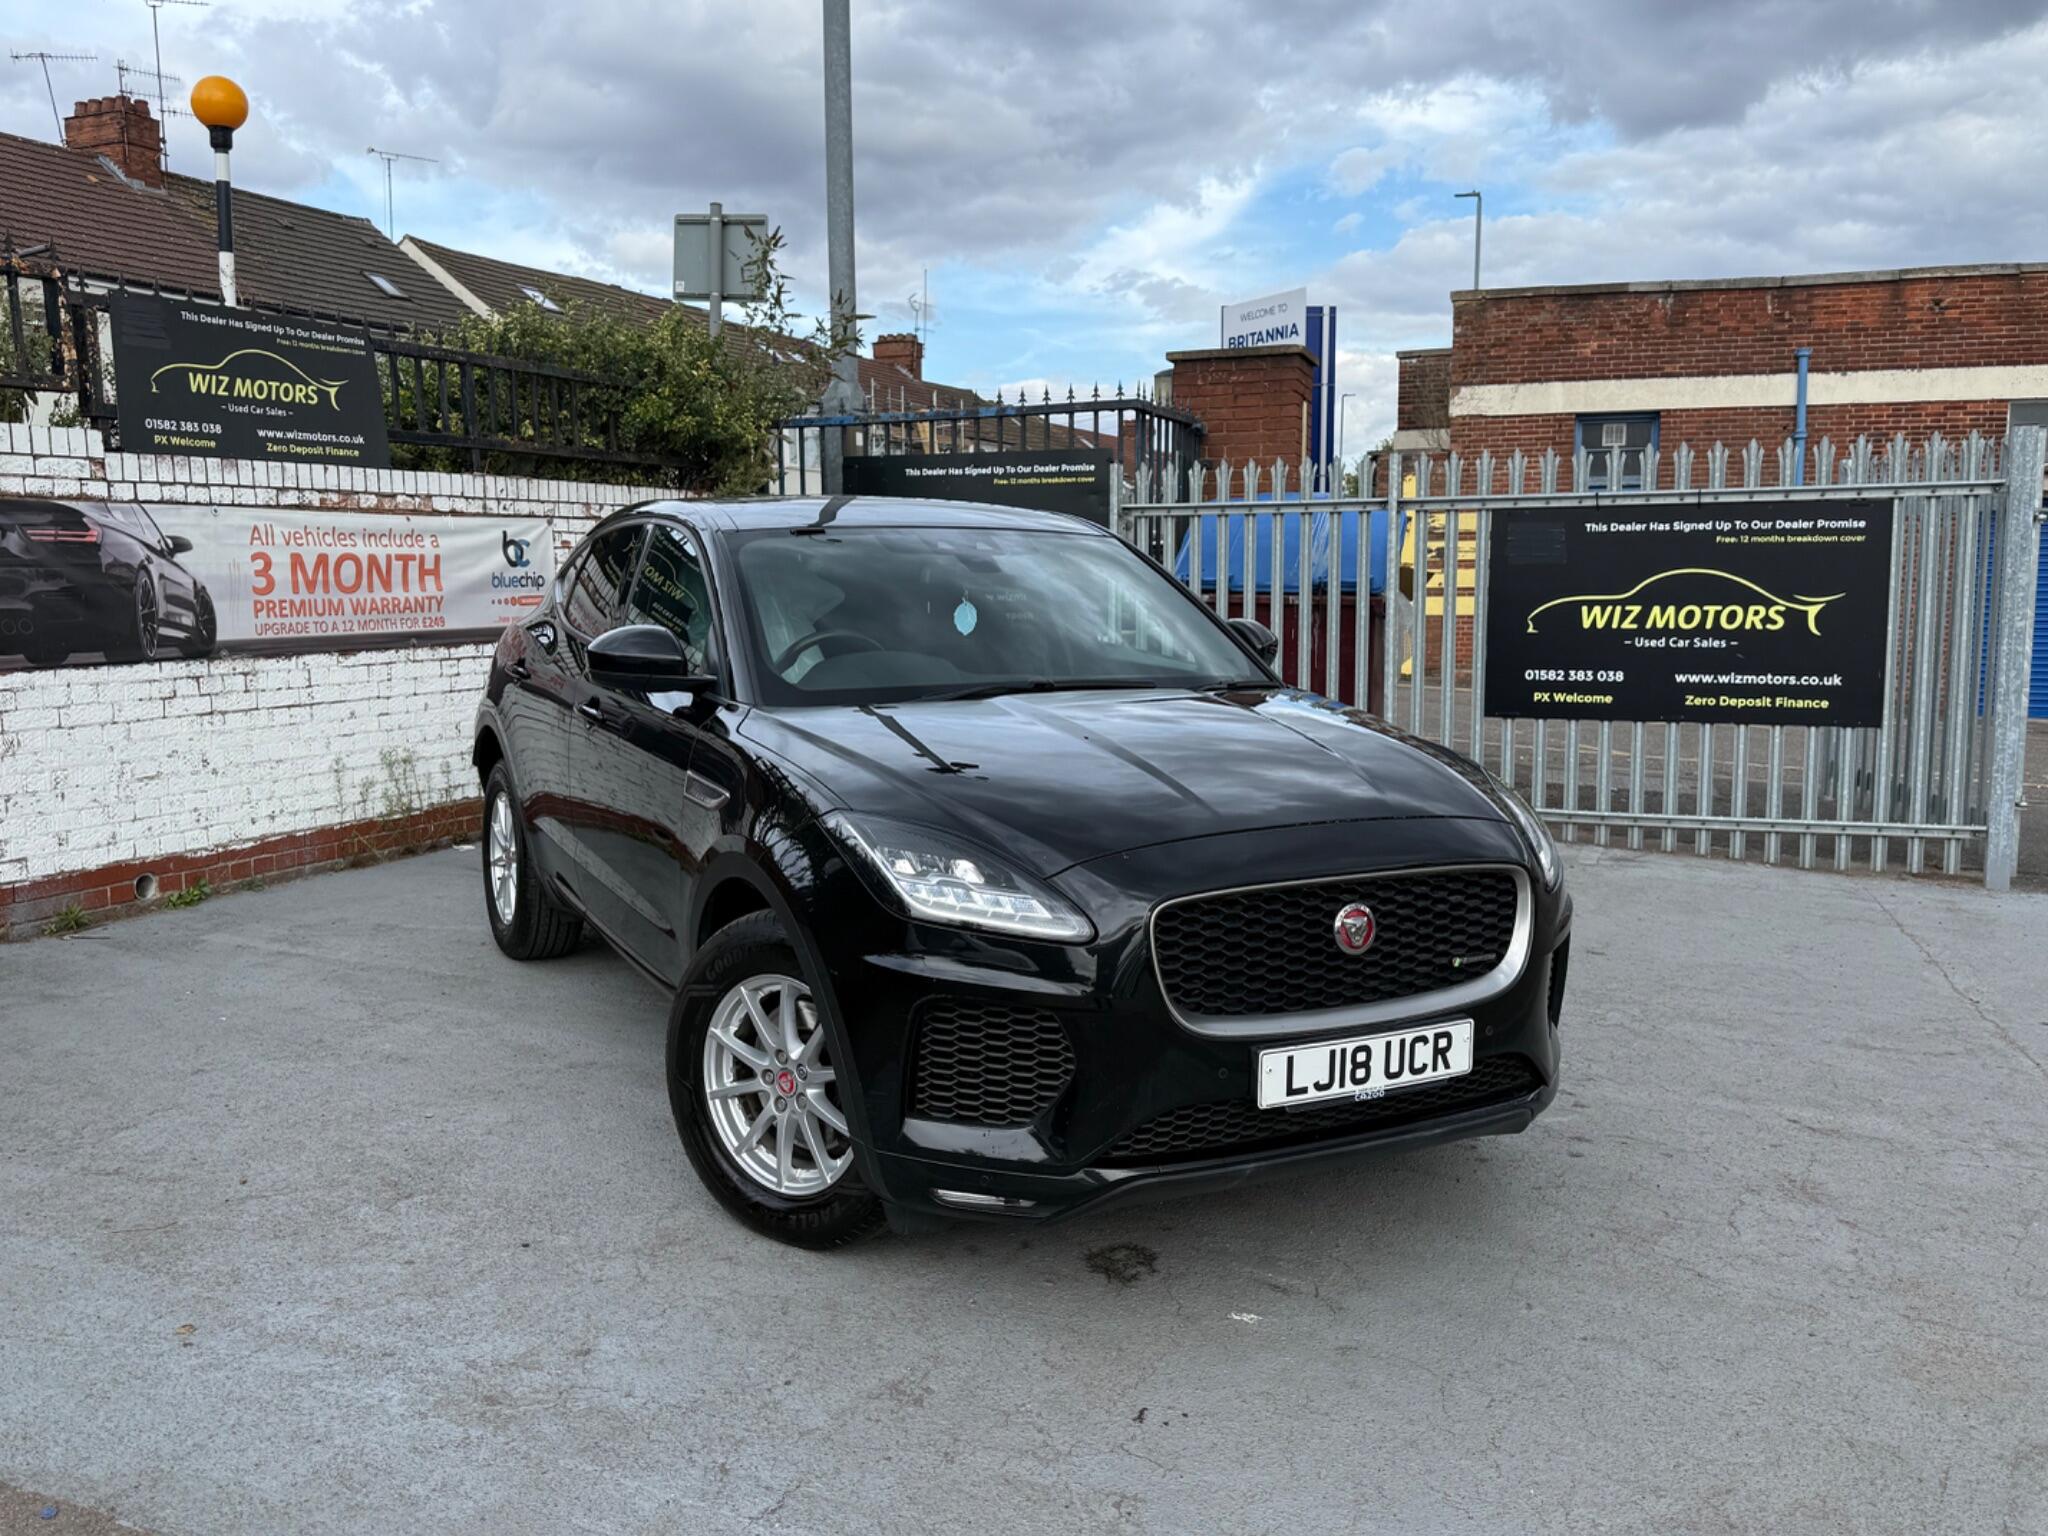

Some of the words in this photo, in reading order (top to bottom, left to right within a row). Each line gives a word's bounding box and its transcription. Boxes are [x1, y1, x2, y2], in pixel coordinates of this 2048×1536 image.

[1240, 305, 1276, 322] WELCOME
[1278, 303, 1288, 312] TO
[180, 311, 199, 322] This
[200, 313, 227, 326] Dealer
[229, 317, 243, 328] Has
[245, 320, 272, 333] Signed
[273, 326, 285, 336] Up
[285, 327, 295, 336] To
[296, 329, 310, 338] Our
[311, 331, 335, 342] Dealer
[336, 335, 365, 346] Promise
[1228, 322, 1299, 349] BRITANNIA
[188, 371, 230, 396] WIZ
[233, 377, 318, 405] MOTORS
[227, 403, 249, 414] Used
[250, 405, 264, 415] Car
[266, 407, 287, 417] Sales
[145, 418, 177, 431] 01582
[180, 420, 200, 432] 383
[202, 421, 222, 434] 038
[154, 435, 168, 445] PX
[170, 436, 216, 448] Welcome
[257, 428, 365, 445] www.wizmotors.co.uk
[266, 443, 288, 453] Zero
[289, 444, 324, 456] Deposit
[325, 446, 360, 457] Finance
[905, 468, 921, 476] This
[922, 467, 947, 476] Dealer
[949, 467, 963, 475] Has
[964, 465, 992, 476] Signed
[993, 466, 1004, 475] Up
[1006, 465, 1016, 474] To
[1017, 465, 1032, 474] Our
[1033, 464, 1060, 473] Dealer
[1061, 462, 1095, 472] Promise
[1041, 476, 1076, 484] breakdown
[1585, 522, 1608, 532] This
[1610, 521, 1647, 531] Dealer
[1650, 521, 1670, 531] Has
[1673, 520, 1712, 532] Signed
[1715, 520, 1731, 532] Up
[1734, 520, 1749, 530] To
[1751, 519, 1773, 530] Our
[1775, 519, 1814, 529] Dealer
[1817, 518, 1866, 529] Promise
[250, 524, 275, 546] All
[280, 525, 358, 547] vehicles
[362, 527, 424, 548] include
[430, 533, 440, 548] a
[1740, 535, 1749, 543] 12
[1750, 535, 1785, 543] months
[1787, 534, 1838, 543] breakdown
[250, 552, 276, 596] 3
[289, 552, 444, 595] MONTH
[491, 571, 546, 591] bluechip
[253, 599, 345, 619] PREMIUM
[349, 596, 445, 616] WARRANTY
[254, 620, 310, 636] UPGRADE
[313, 620, 329, 634] TO
[331, 620, 339, 633] A
[341, 619, 355, 632] 12
[357, 617, 398, 631] MONTH
[400, 617, 420, 630] FOR
[422, 616, 446, 629] £249
[1580, 605, 1642, 629] WIZ
[1645, 605, 1786, 631] MOTORS
[1634, 637, 1665, 648] Used
[1669, 637, 1690, 648] Car
[1693, 637, 1726, 648] Sales
[1524, 669, 1565, 681] 01582
[1568, 670, 1594, 682] 383
[1597, 670, 1624, 682] 038
[1674, 672, 1843, 687] www.wizmotors.co.uk
[1533, 692, 1550, 702] PX
[1553, 692, 1613, 704] Welcome
[1685, 695, 1716, 706] Zero
[1719, 696, 1772, 709] Deposit
[1775, 697, 1830, 709] Finance
[1285, 1044, 1372, 1097] LJ18
[1384, 1030, 1453, 1080] UCR
